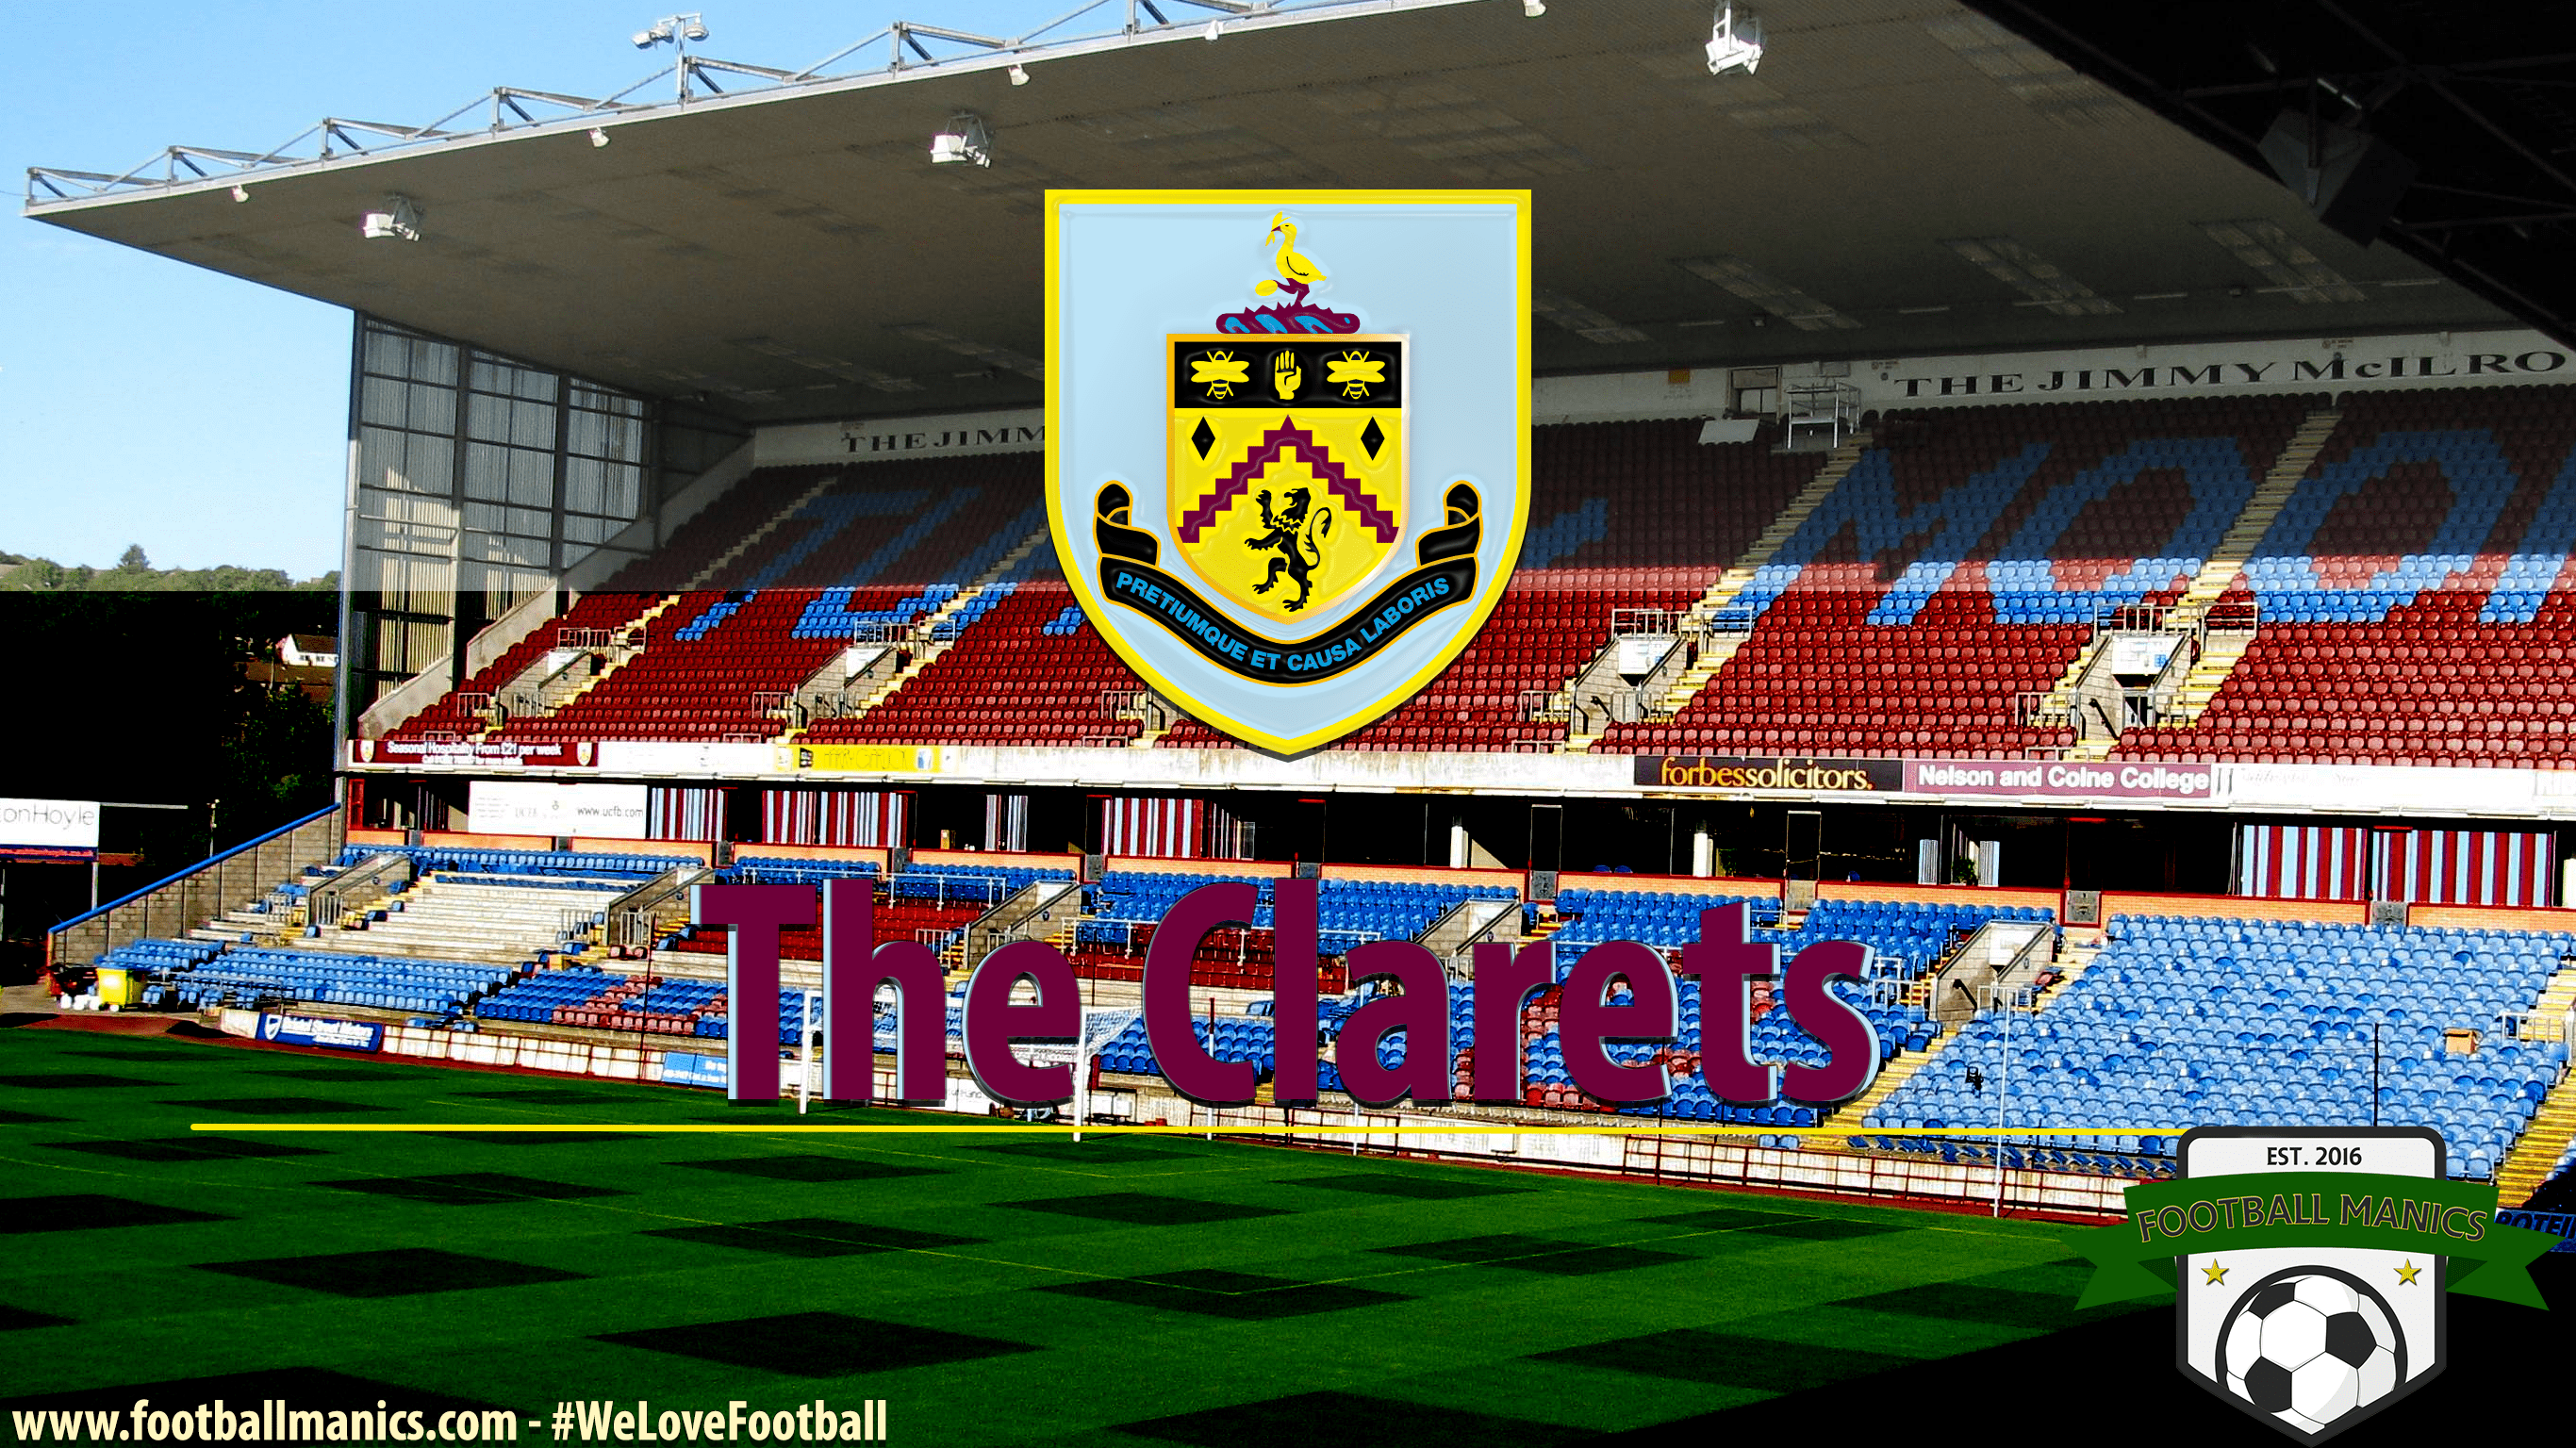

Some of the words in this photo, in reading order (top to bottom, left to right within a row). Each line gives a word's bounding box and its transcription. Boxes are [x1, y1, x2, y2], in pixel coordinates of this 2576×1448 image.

[1893, 371, 2025, 397] THE
[2038, 360, 2278, 391] JIMMY
[841, 433, 927, 453] THE
[388, 742, 426, 753] Seasonal
[476, 743, 500, 754] From
[519, 745, 536, 757] per
[537, 745, 561, 756] week
[1660, 757, 1874, 790] forbessolicitors.
[1919, 764, 1994, 787] Nelson
[1999, 765, 2041, 788] and
[2047, 765, 2115, 789] Colne
[2120, 765, 2209, 794] College
[0, 802, 95, 831] onHoyle
[577, 805, 644, 818] www.ucfb.com
